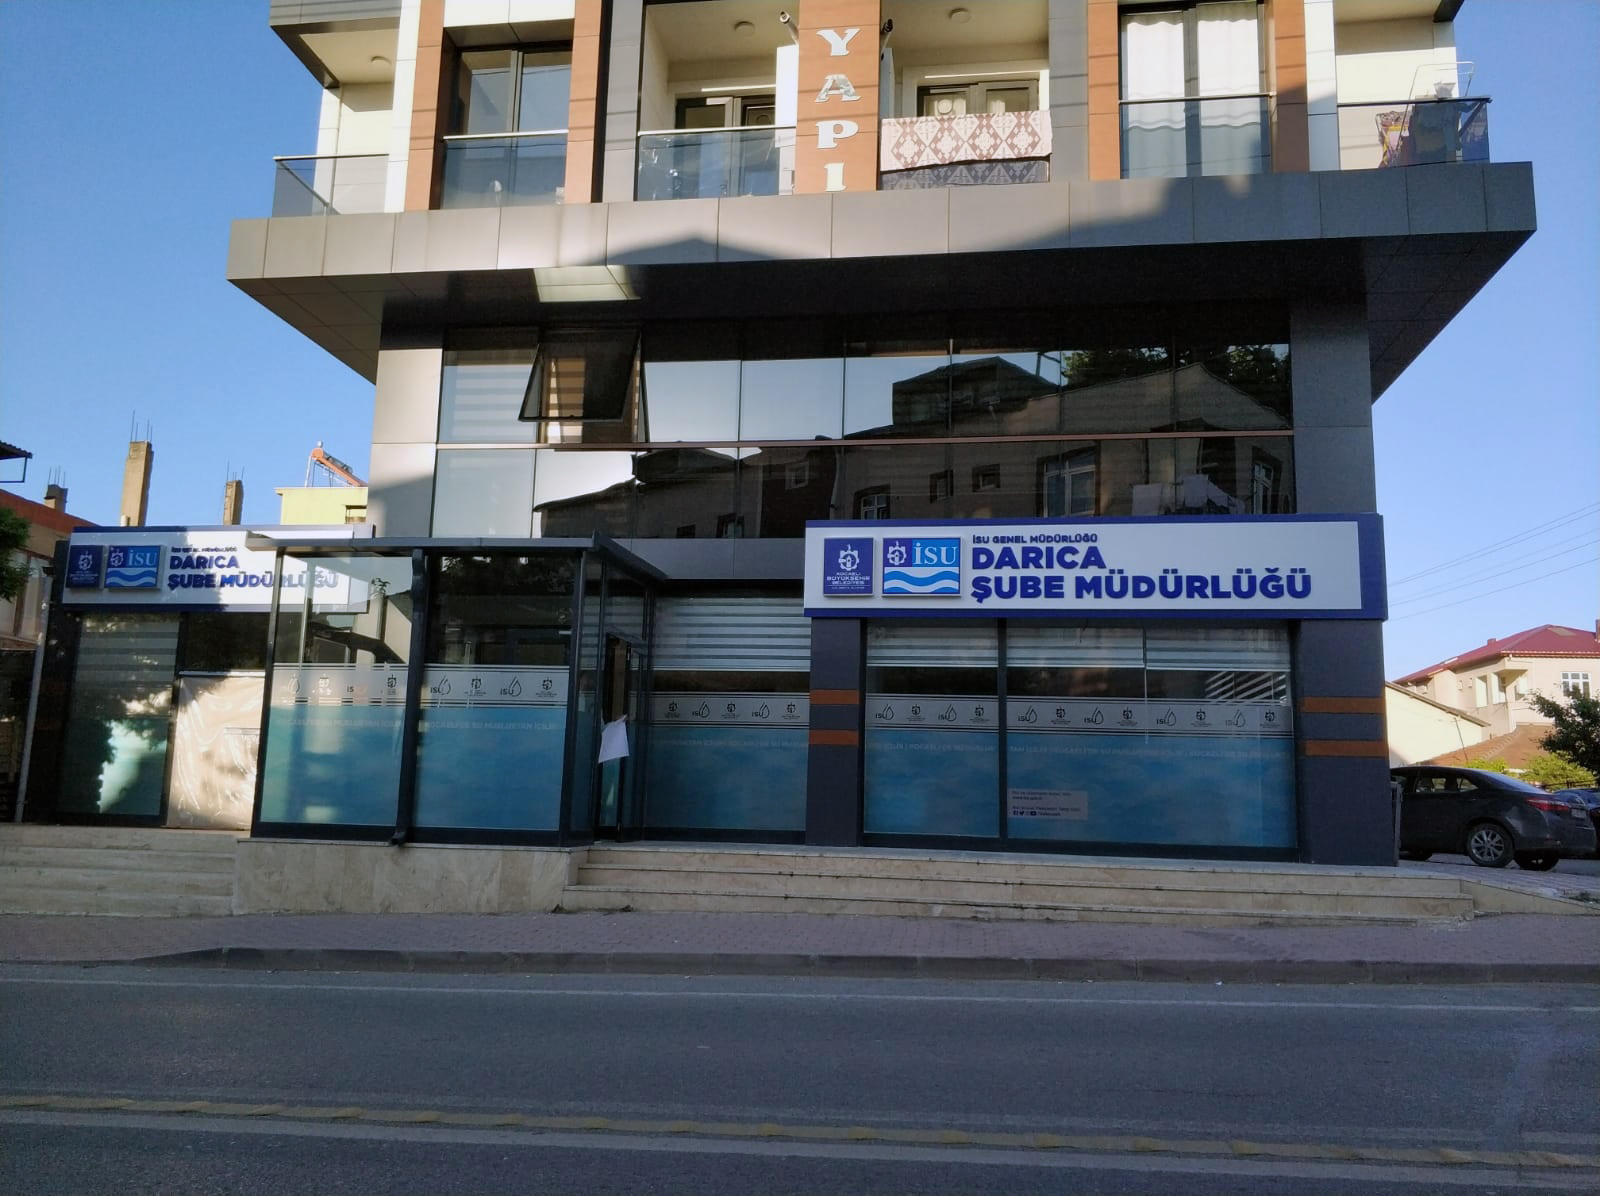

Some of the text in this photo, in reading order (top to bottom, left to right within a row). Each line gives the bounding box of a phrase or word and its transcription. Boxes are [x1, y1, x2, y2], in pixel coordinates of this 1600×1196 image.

[972, 533, 1098, 544] İSU GENEL MÜDÜRLÜĞÜ
[128, 550, 158, 566] İSU
[169, 555, 240, 570] DARICA
[912, 542, 959, 565] İSU
[972, 546, 1107, 570] DARICA
[168, 573, 217, 591] ŞUBE
[971, 567, 1312, 604] ŞUBE MÜDÜRLÜĞÜ
